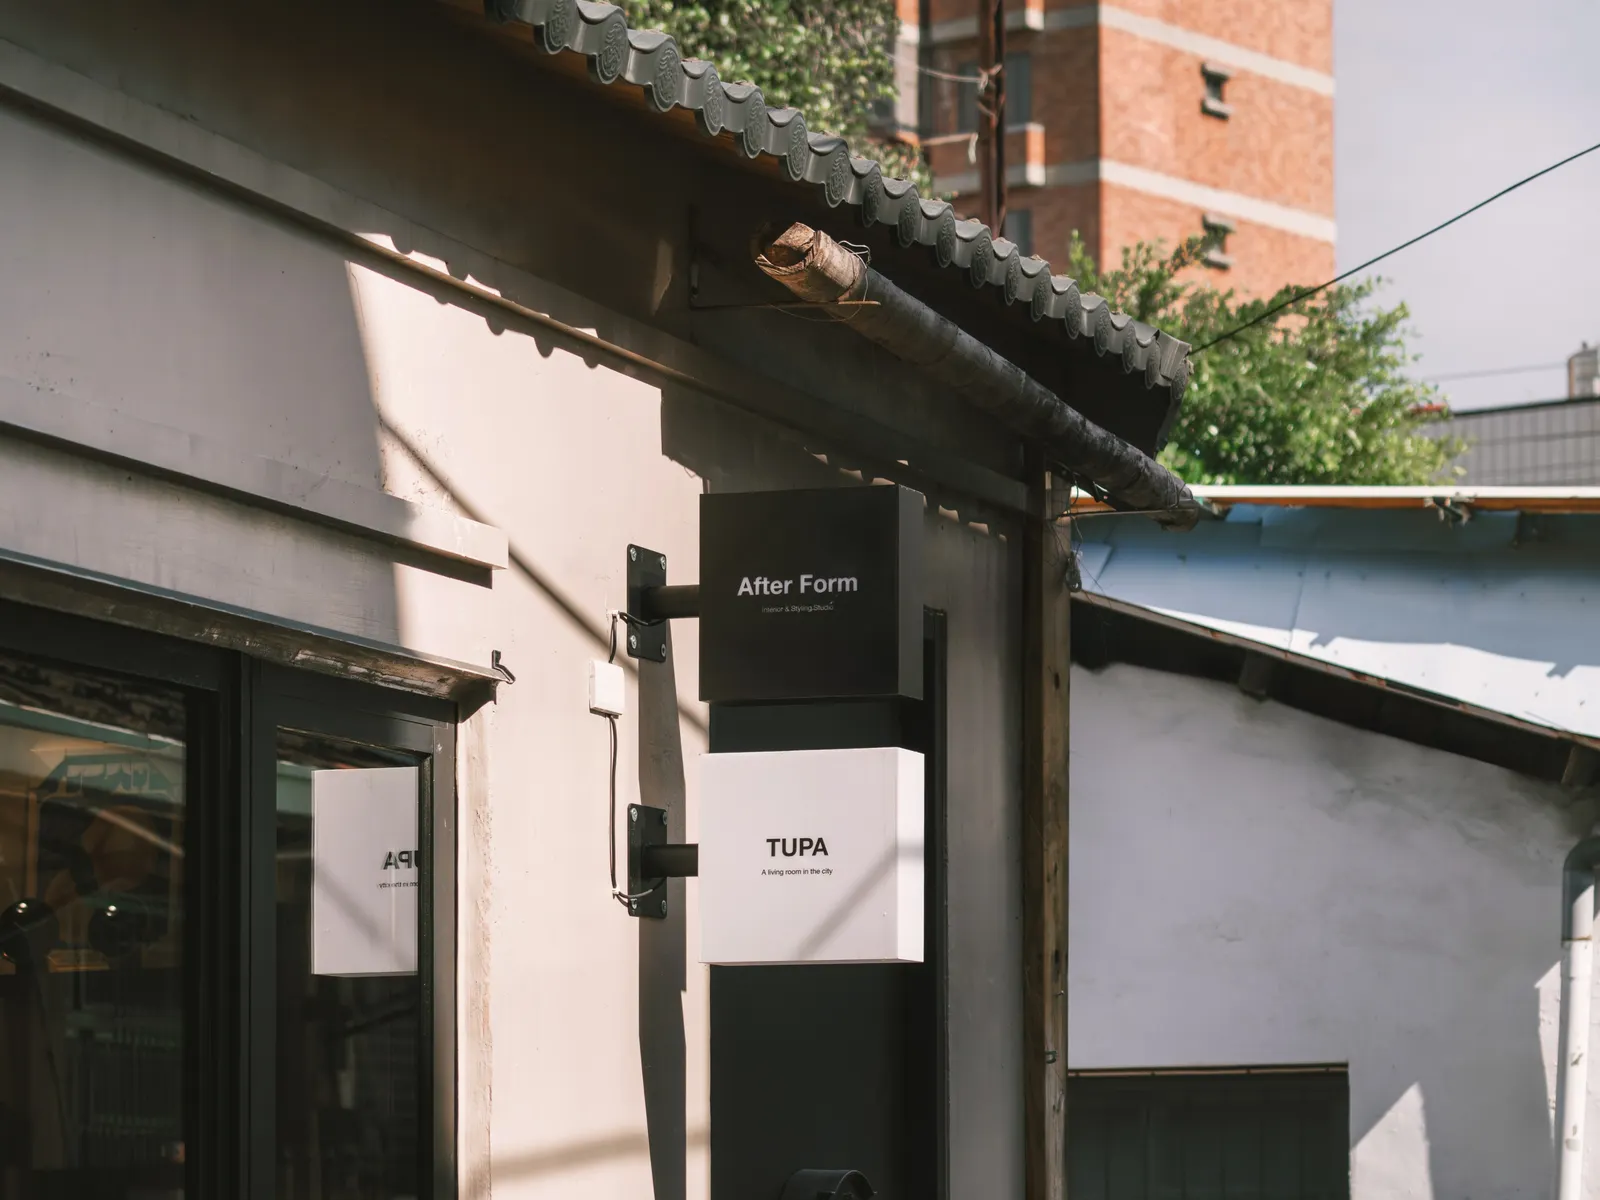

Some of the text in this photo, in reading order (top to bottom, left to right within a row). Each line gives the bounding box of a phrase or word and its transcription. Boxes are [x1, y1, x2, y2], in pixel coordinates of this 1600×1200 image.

[737, 574, 858, 597] After Form
[761, 606, 784, 614] Interior
[791, 604, 813, 613] Styling
[766, 837, 829, 857] TUPA
[821, 868, 833, 876] city
